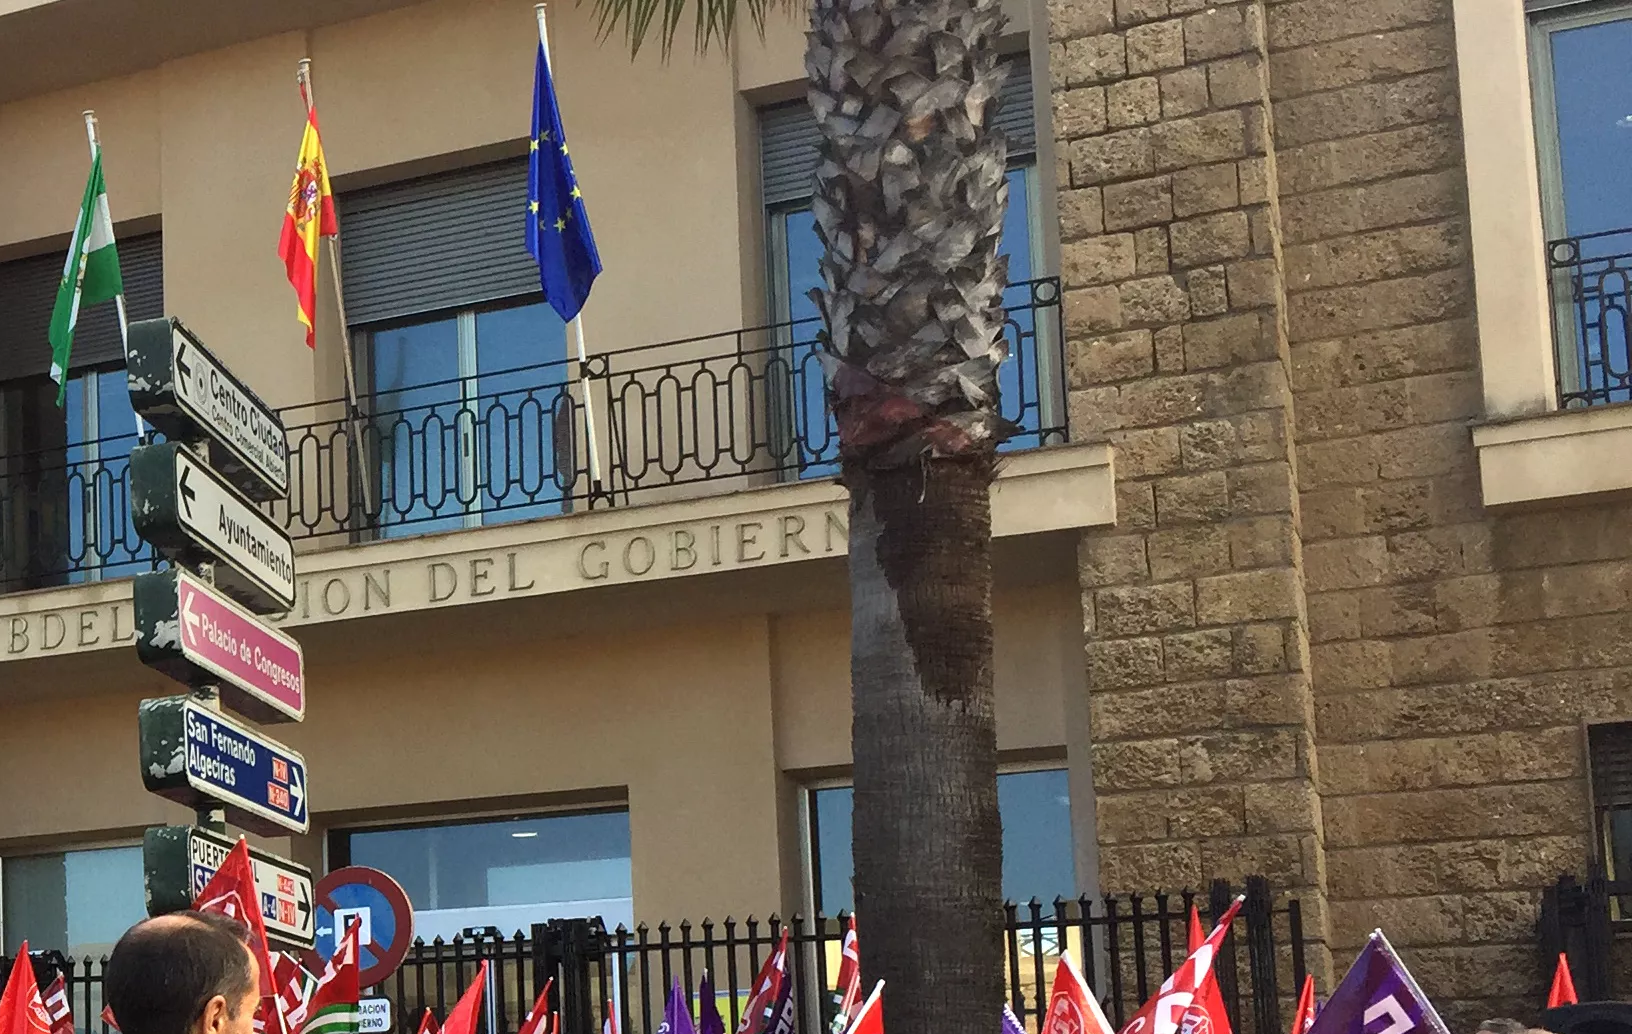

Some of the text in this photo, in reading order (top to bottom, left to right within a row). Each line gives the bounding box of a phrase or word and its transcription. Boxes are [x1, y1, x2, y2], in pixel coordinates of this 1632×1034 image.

[210, 369, 285, 461] Centro Ciudad
[218, 503, 293, 585] Ayuntamiento
[427, 552, 535, 603] DEL
[577, 510, 850, 580] GOBIERN
[201, 612, 301, 694] Palacio de Congresos
[187, 711, 256, 767] San Fernando
[189, 743, 236, 787] Algeciras
[192, 838, 232, 871] PUERT
[262, 893, 276, 919] A-4
